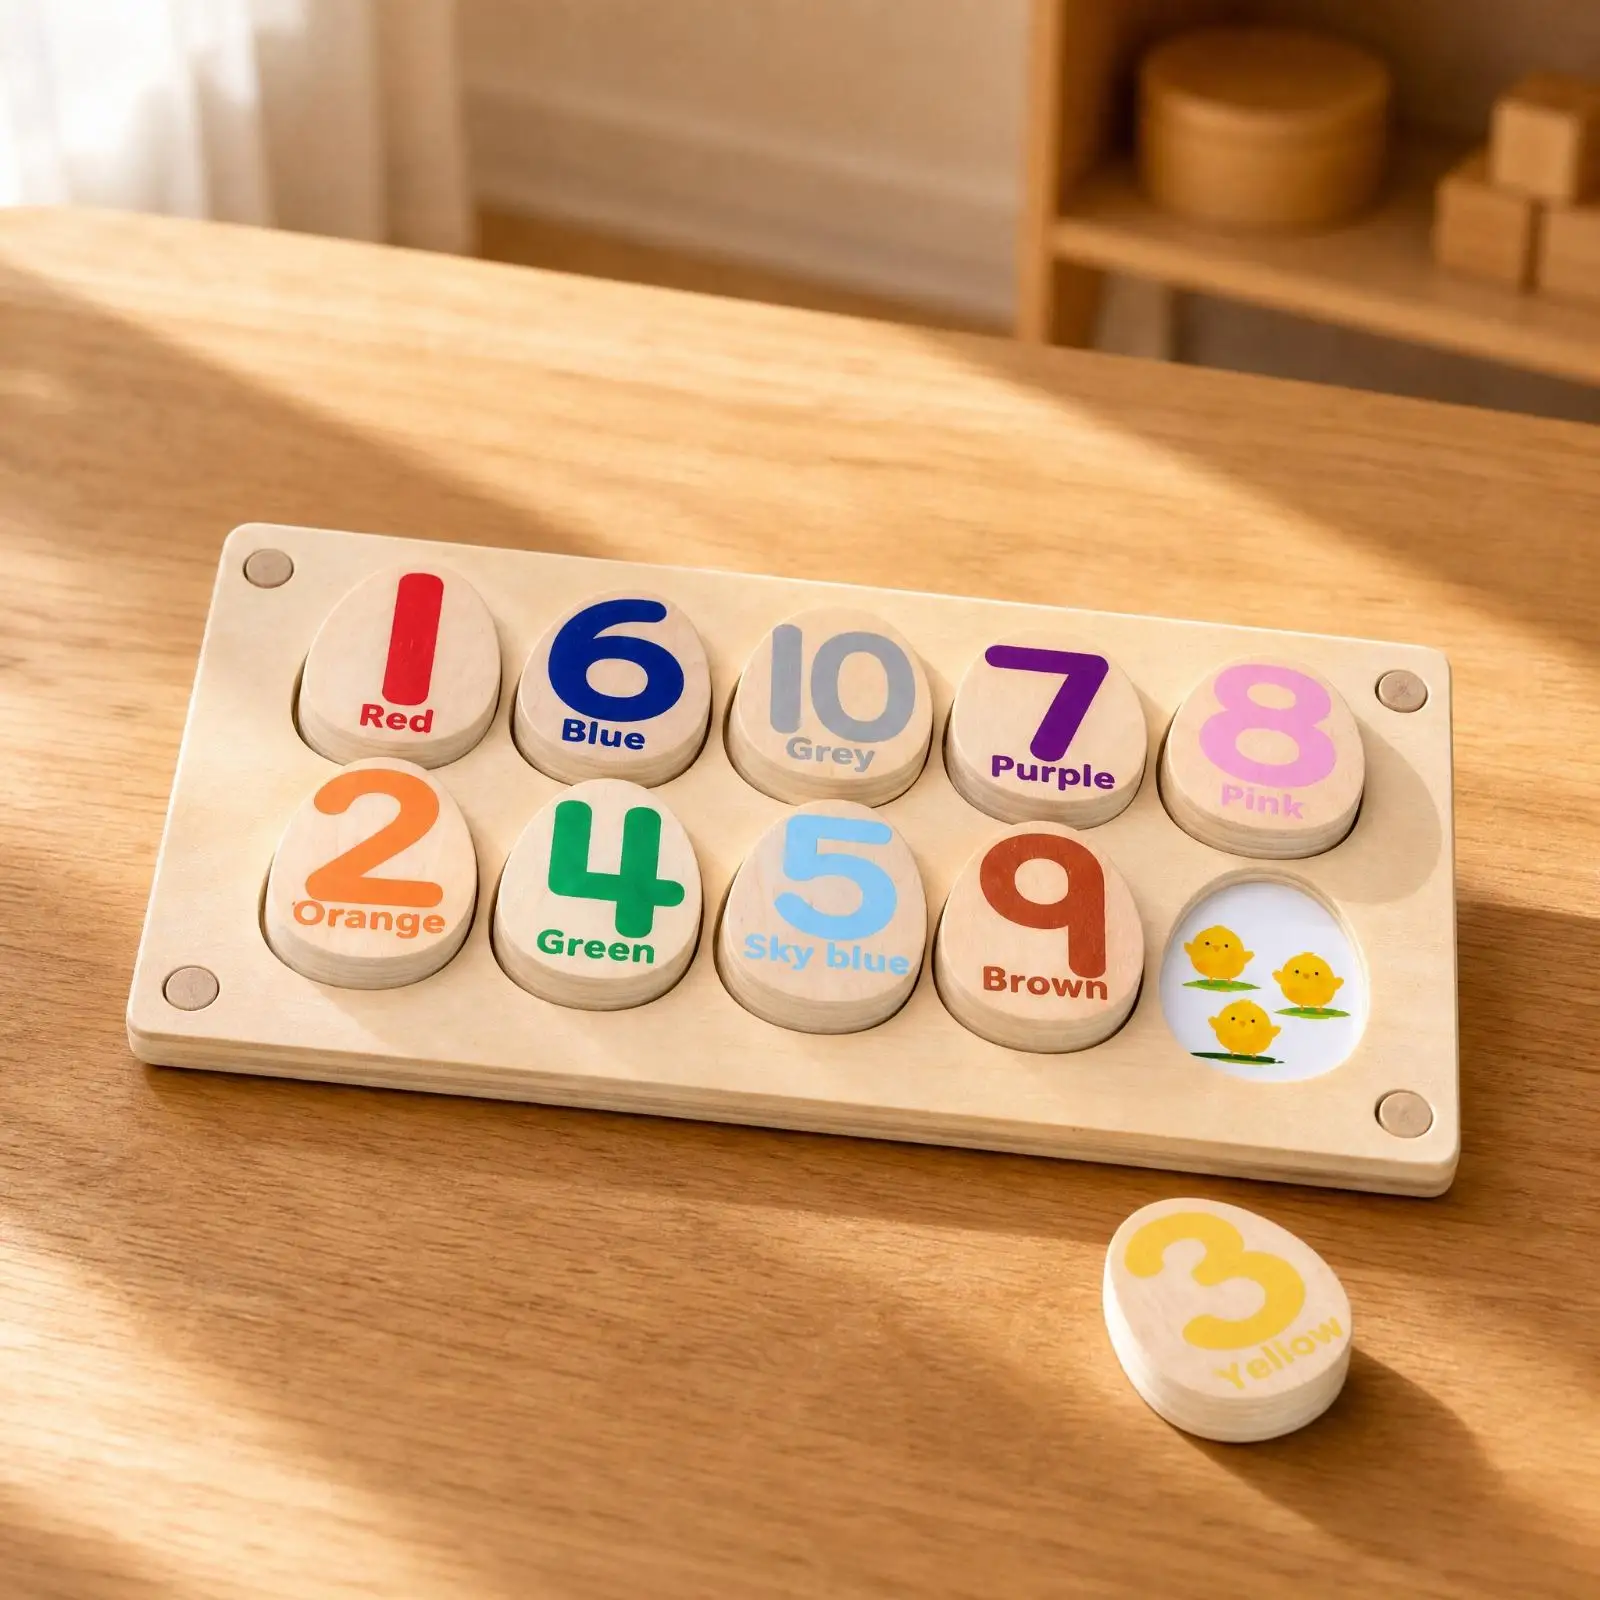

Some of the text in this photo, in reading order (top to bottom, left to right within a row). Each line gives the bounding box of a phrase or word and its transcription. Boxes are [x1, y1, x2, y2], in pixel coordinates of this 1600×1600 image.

[382, 572, 444, 706] 1
[548, 598, 685, 723] 6
[769, 623, 916, 743] 10
[359, 703, 434, 734] Red
[561, 718, 647, 750] Blue
[984, 644, 1109, 762] 7
[1199, 663, 1337, 789] 8
[785, 736, 875, 773] Grey
[991, 754, 1116, 791] Purple
[1220, 782, 1305, 820] Pink
[305, 768, 443, 908] 2
[548, 799, 685, 938] 4
[774, 814, 897, 941] 5
[291, 899, 446, 939] Orange
[536, 928, 655, 964] Green
[979, 832, 1107, 978] 9
[743, 932, 911, 976] Sky blue
[982, 965, 1109, 1001] Brown
[1124, 1211, 1306, 1351] 3
[1211, 1316, 1343, 1390] Yellow
